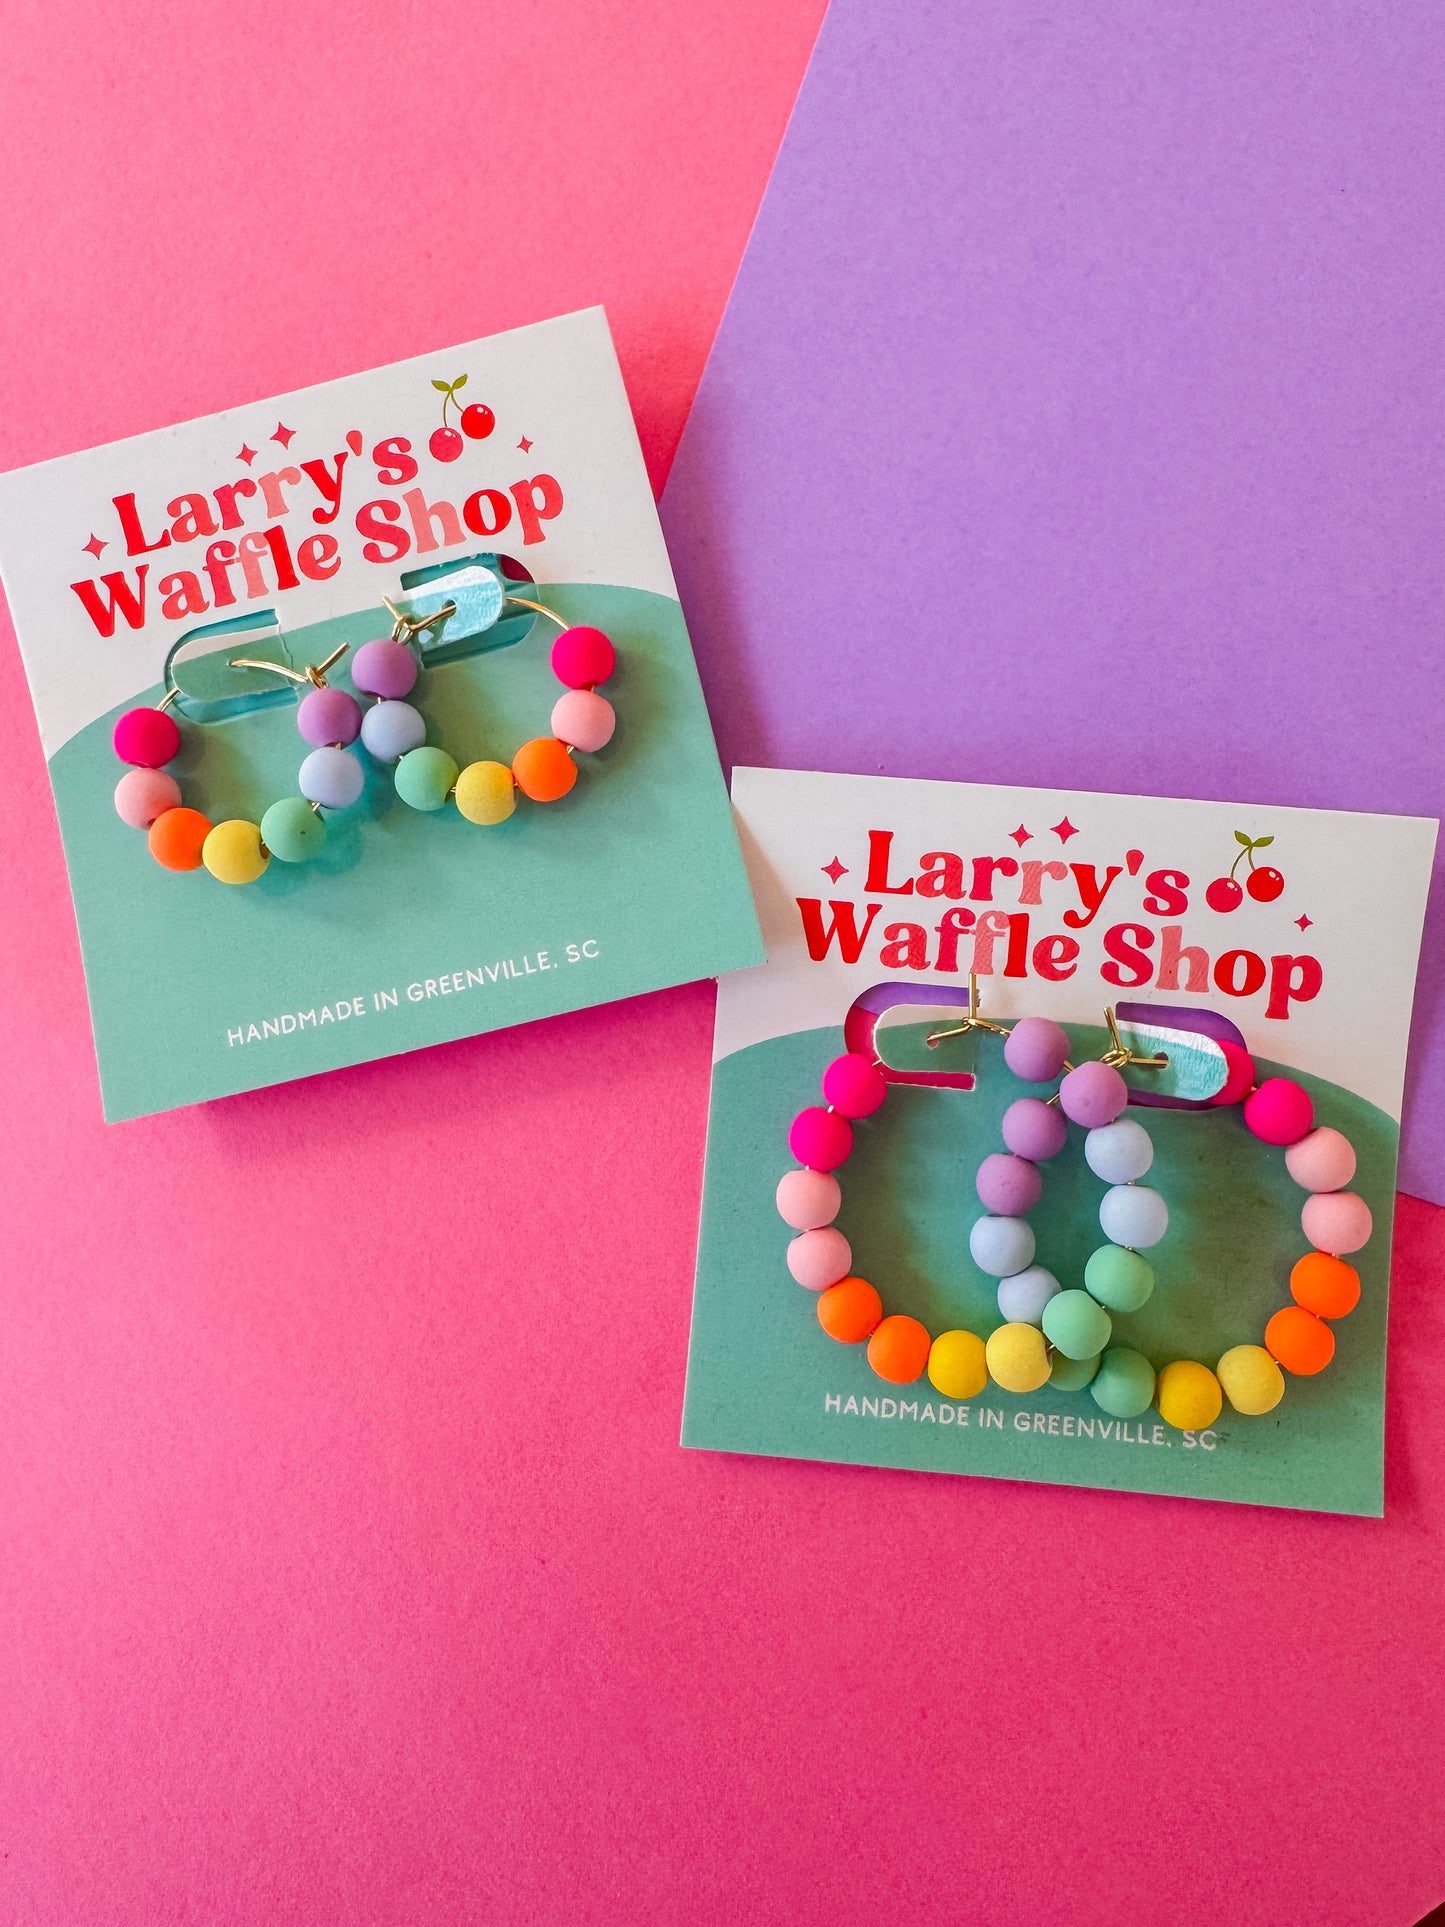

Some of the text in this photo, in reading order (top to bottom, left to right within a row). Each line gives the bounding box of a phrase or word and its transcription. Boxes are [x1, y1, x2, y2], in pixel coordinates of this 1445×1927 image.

[113, 430, 417, 557] Larry's
[71, 472, 564, 638] Waffle Shop
[864, 829, 1189, 929] Larry's
[227, 938, 600, 1047] HANDMADE IN GREENVILLE, SC
[796, 897, 1323, 1019] Waffle Shop
[824, 1393, 1217, 1450] HANDMADE IN GREENVILLE, SC
